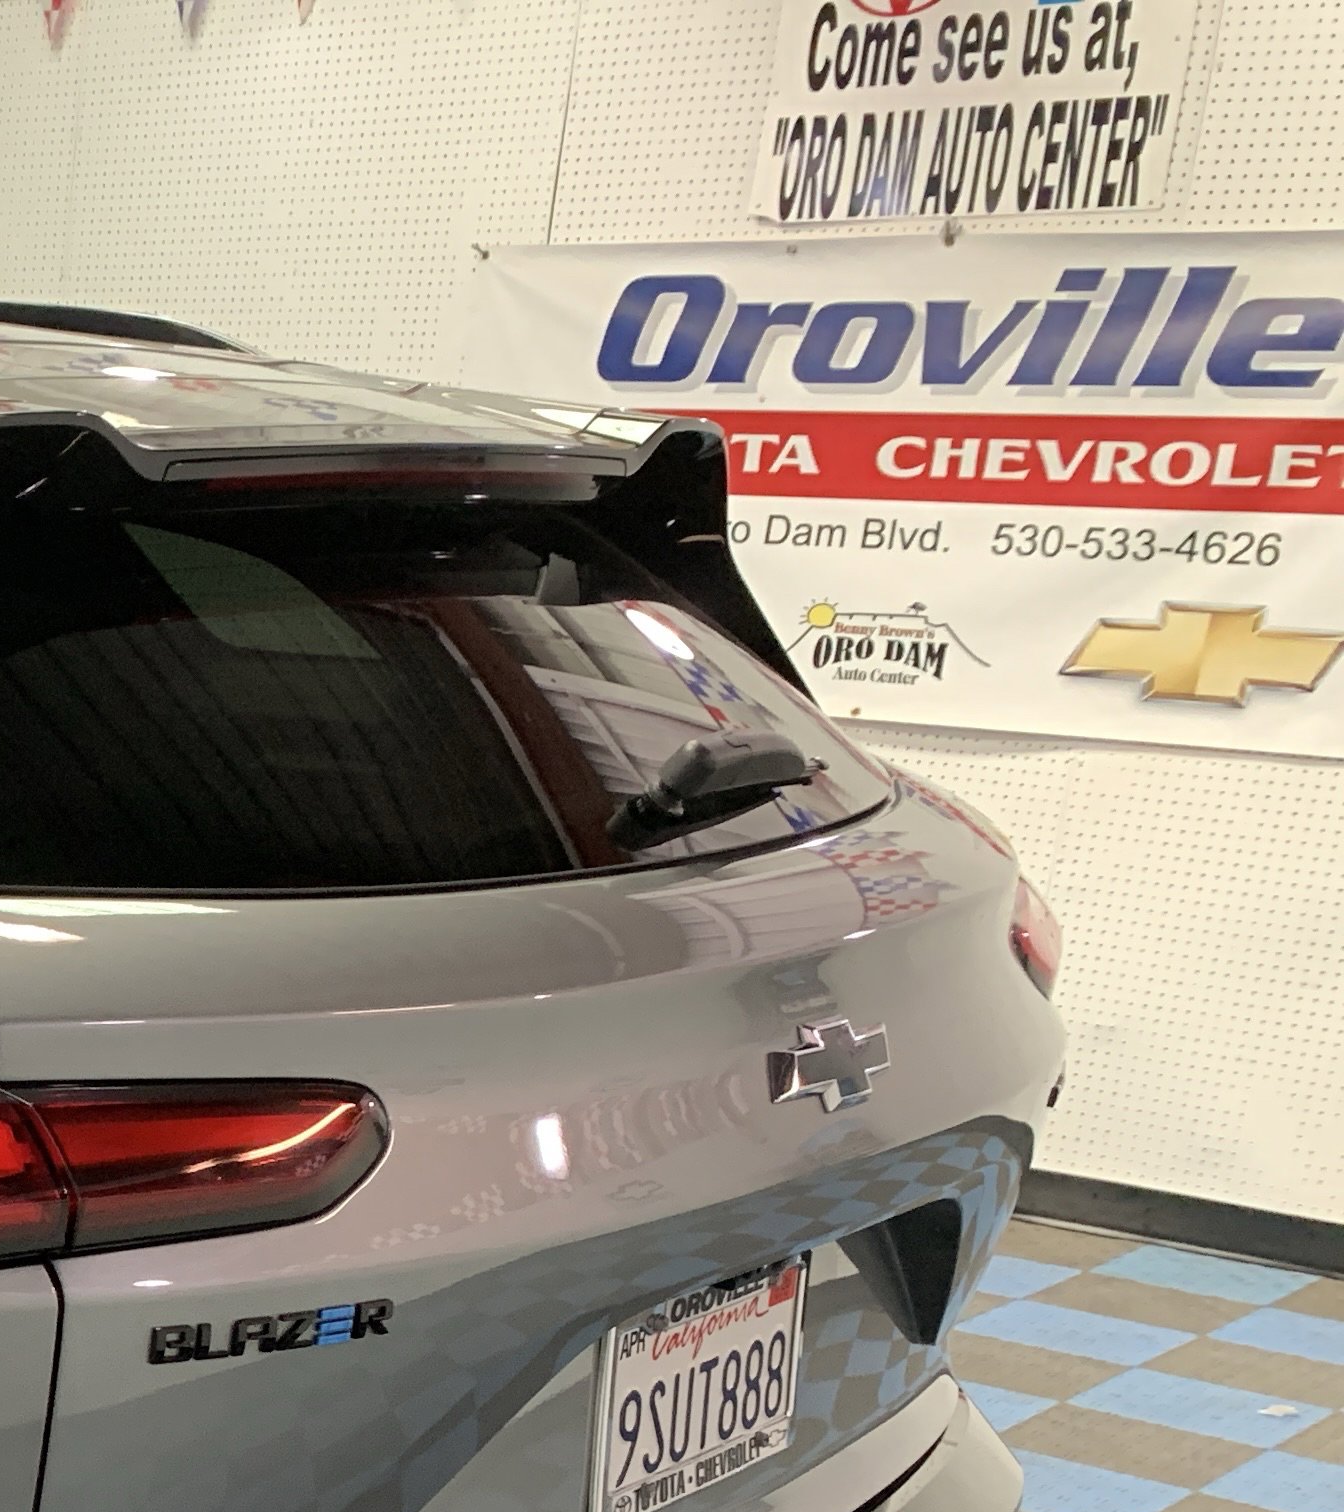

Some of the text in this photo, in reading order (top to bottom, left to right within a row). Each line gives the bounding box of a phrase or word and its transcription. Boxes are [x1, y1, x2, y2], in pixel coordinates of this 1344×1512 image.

[808, 0, 1140, 92] Come see us at,
[773, 94, 1170, 221] "ORO DAM AUTO CENTER"
[596, 266, 1344, 388] Oroville
[730, 433, 820, 475] TA
[764, 514, 846, 548] Dam
[861, 518, 951, 553] Blvd.
[990, 523, 1282, 567] 530-533-4626
[812, 634, 949, 680] ORO DAM
[834, 621, 935, 639] Benny Brown's
[832, 666, 920, 685] Auto Center
[147, 1298, 394, 1364] BLAZER
[652, 1296, 770, 1361] California
[615, 1329, 786, 1489] 9SUT888
